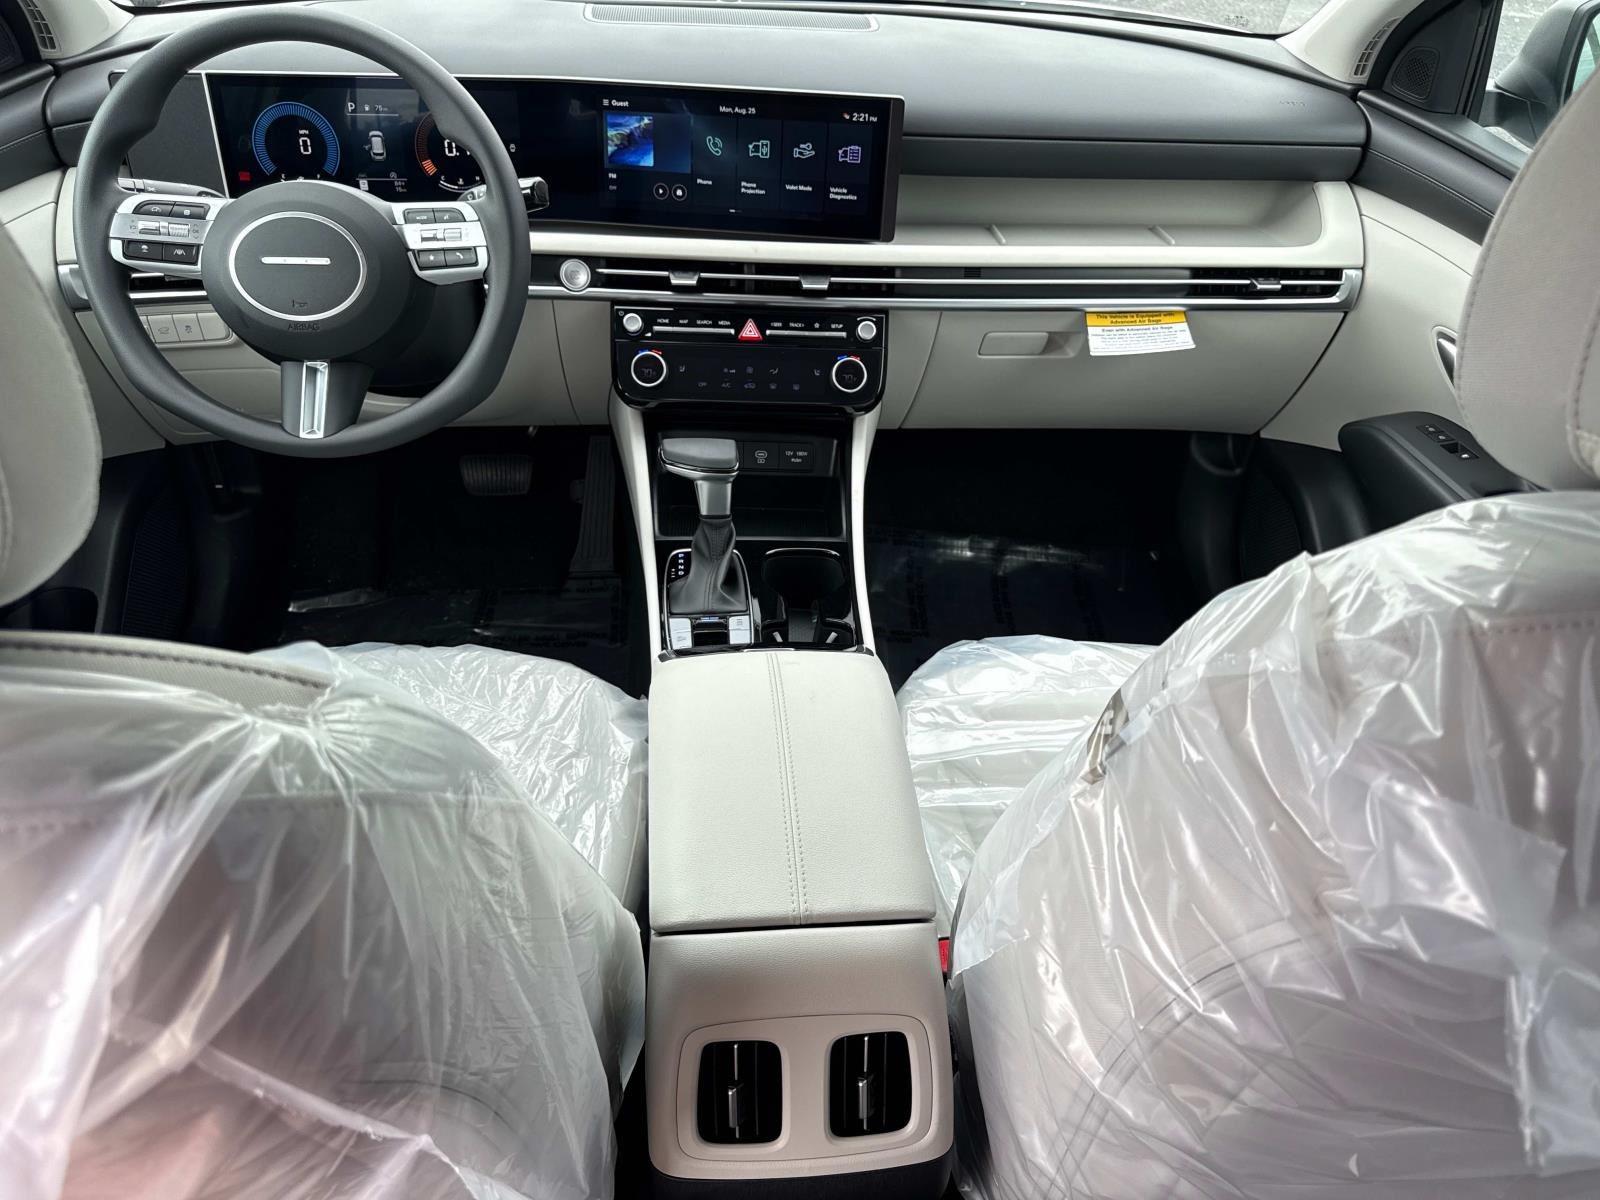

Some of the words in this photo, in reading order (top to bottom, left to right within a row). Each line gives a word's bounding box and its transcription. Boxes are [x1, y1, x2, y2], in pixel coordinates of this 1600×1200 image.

[347, 102, 356, 112] P
[852, 113, 869, 122] 2:21
[299, 137, 312, 155] 0
[741, 187, 766, 195] Projection
